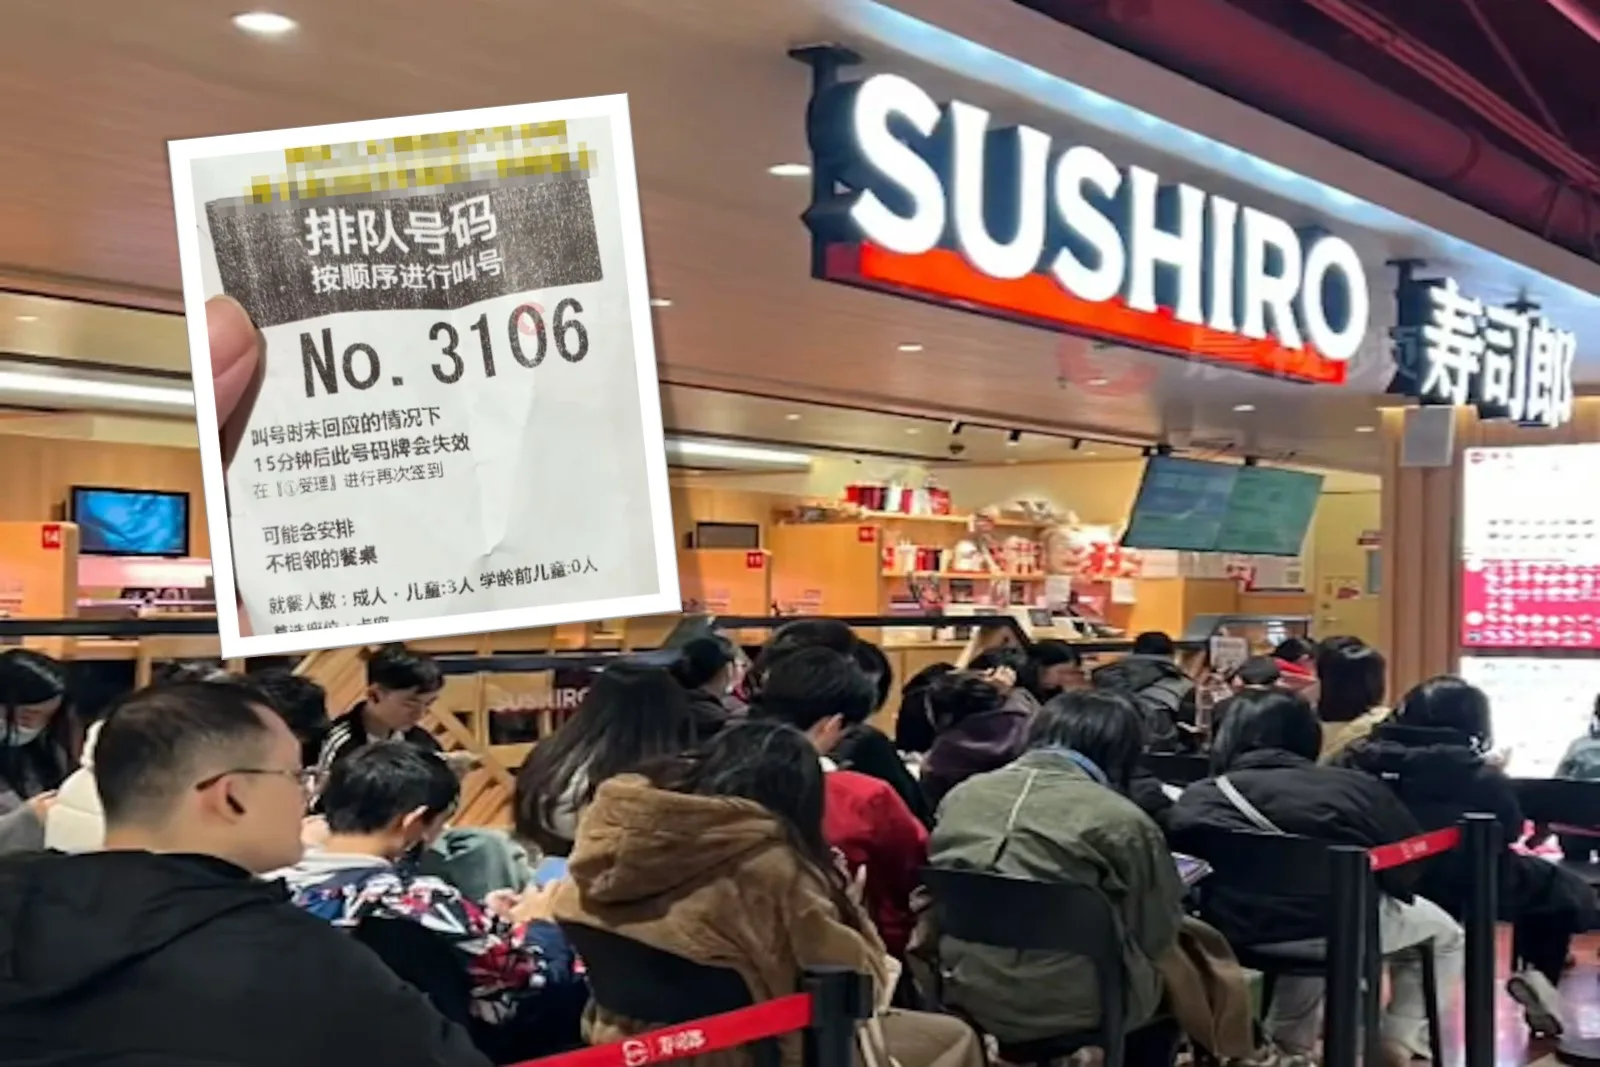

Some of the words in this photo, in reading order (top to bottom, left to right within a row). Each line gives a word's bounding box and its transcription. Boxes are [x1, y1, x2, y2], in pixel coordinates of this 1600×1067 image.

[305, 194, 498, 257] 排队号码
[850, 73, 1369, 362] SUSHIRO
[311, 249, 503, 294] 按顺序进行叫号
[300, 327, 404, 398] No.
[429, 297, 590, 385] 3106
[1421, 277, 1577, 429] 寿司郎
[251, 406, 441, 447] 叫号时未回应的情况下
[254, 432, 471, 473] 15分钟后此号码牌会失效
[261, 517, 356, 546] 可能会安排
[265, 545, 379, 574] 不相邻的餐桌
